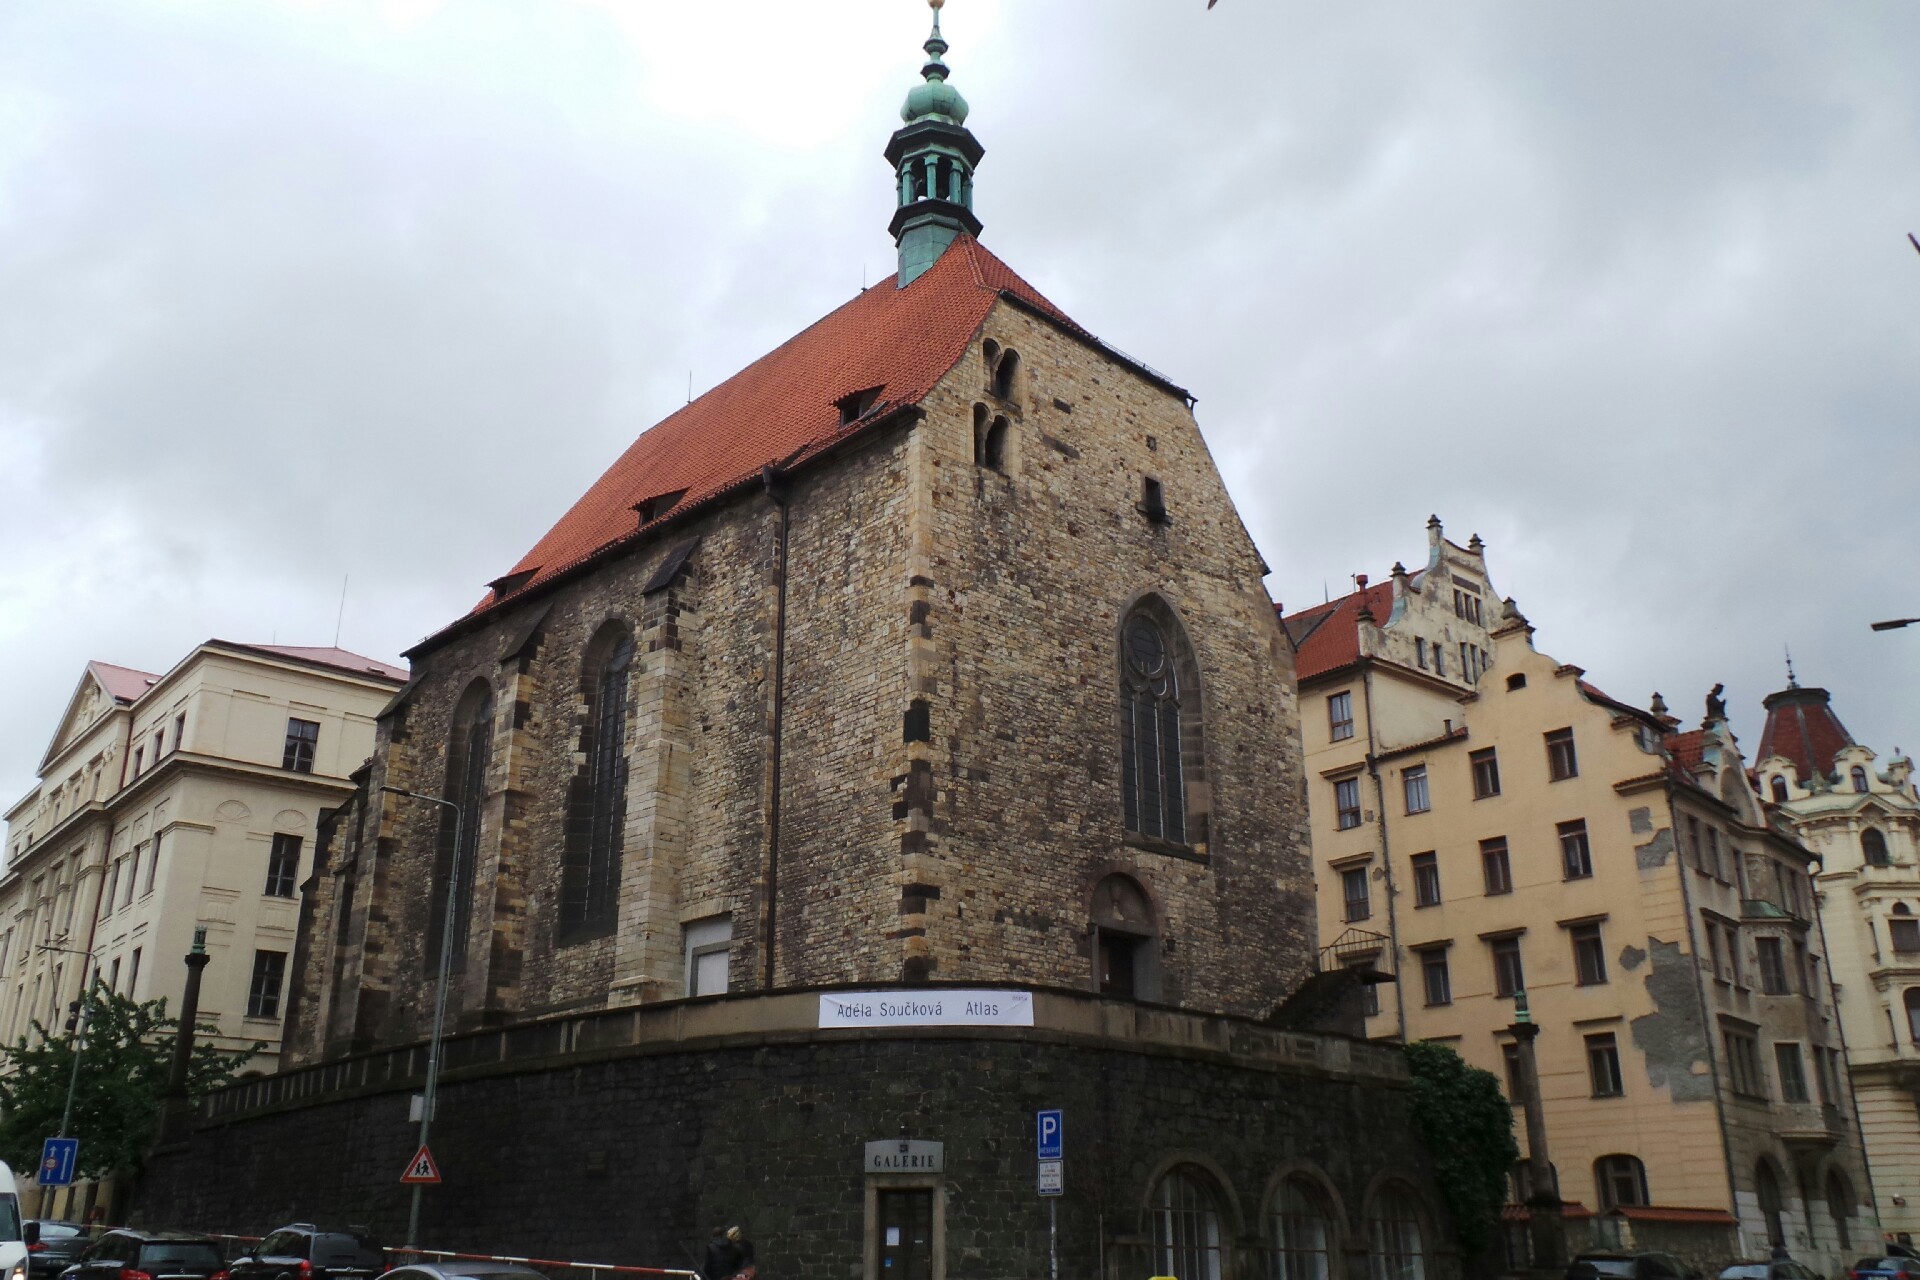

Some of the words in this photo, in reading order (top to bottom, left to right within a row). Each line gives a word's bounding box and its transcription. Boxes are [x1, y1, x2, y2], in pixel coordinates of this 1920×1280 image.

[837, 1003, 872, 1018] Adéla
[880, 1001, 942, 1017] Součková
[965, 1001, 999, 1016] Atlas
[1043, 1117, 1056, 1144] P
[874, 1154, 934, 1168] GALERIE
